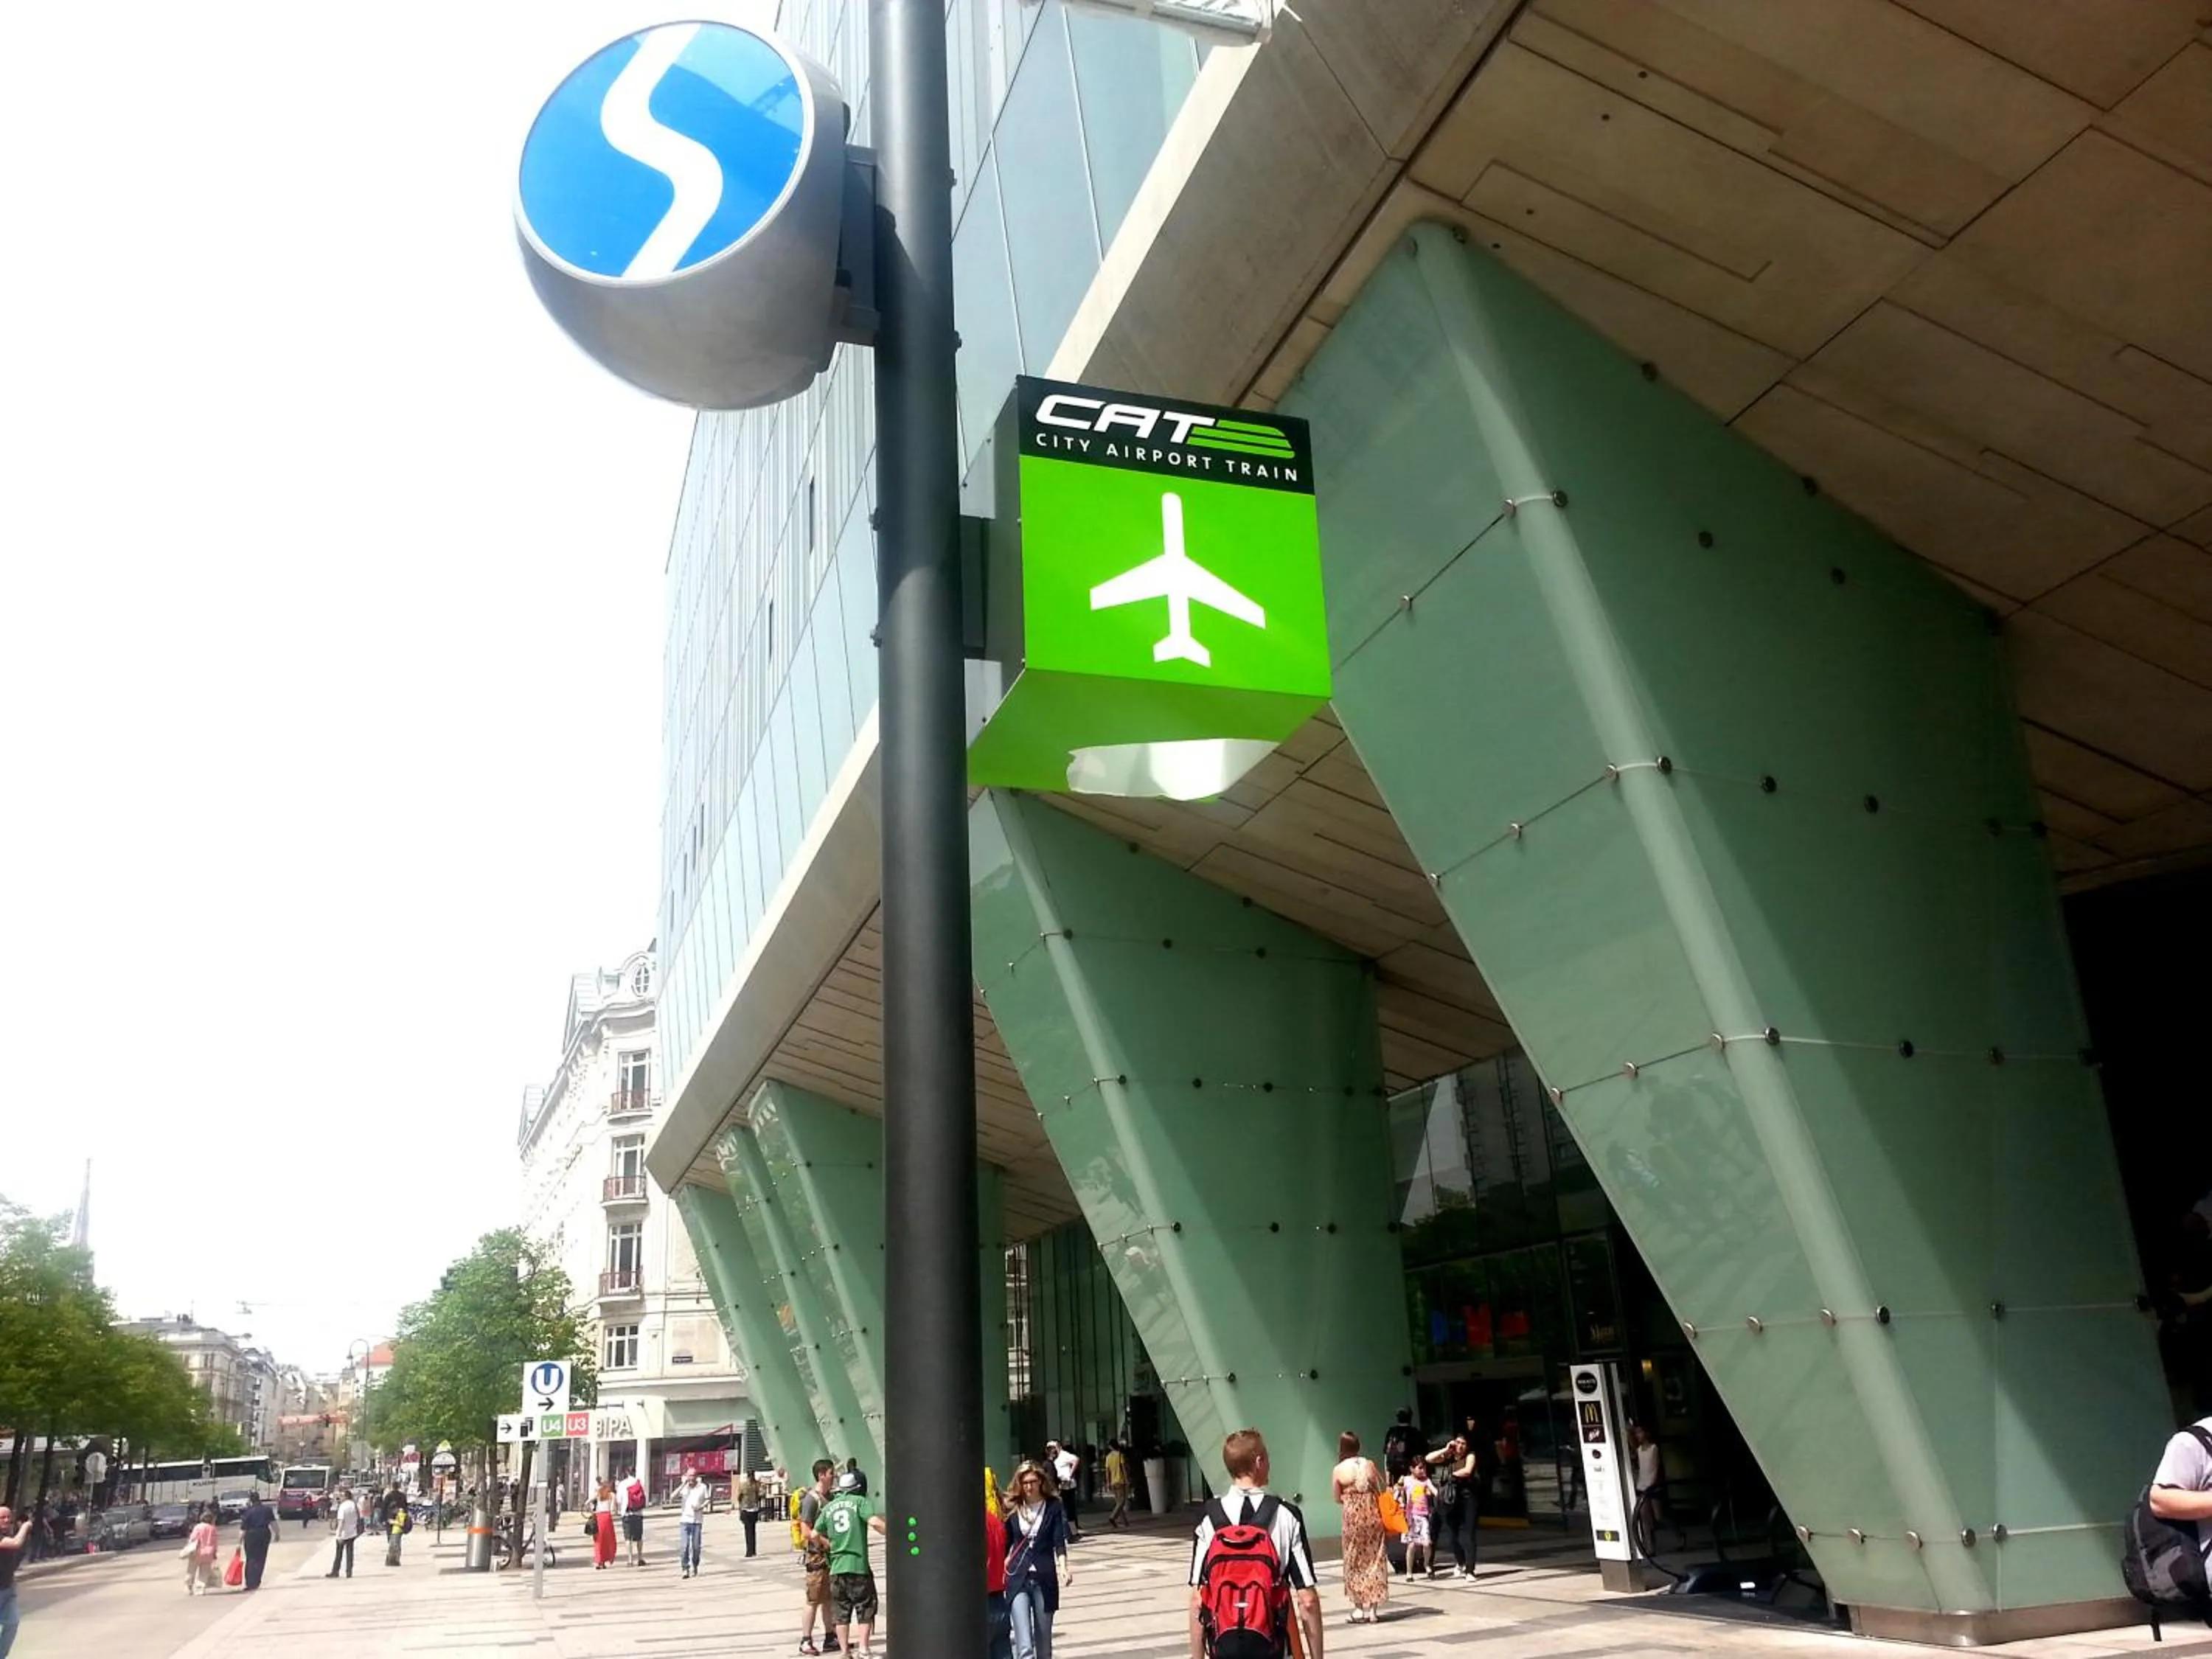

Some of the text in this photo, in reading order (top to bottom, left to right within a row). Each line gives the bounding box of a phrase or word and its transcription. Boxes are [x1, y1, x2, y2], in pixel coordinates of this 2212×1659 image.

[600, 22, 723, 277] S
[1035, 394, 1216, 444] CAT
[1035, 432, 1298, 482] CITY AIRPORT TRAIN
[535, 1368, 560, 1394] U
[542, 1418, 586, 1433] U4 U3
[595, 1416, 634, 1438] BIPA
[833, 1509, 850, 1533] 3
